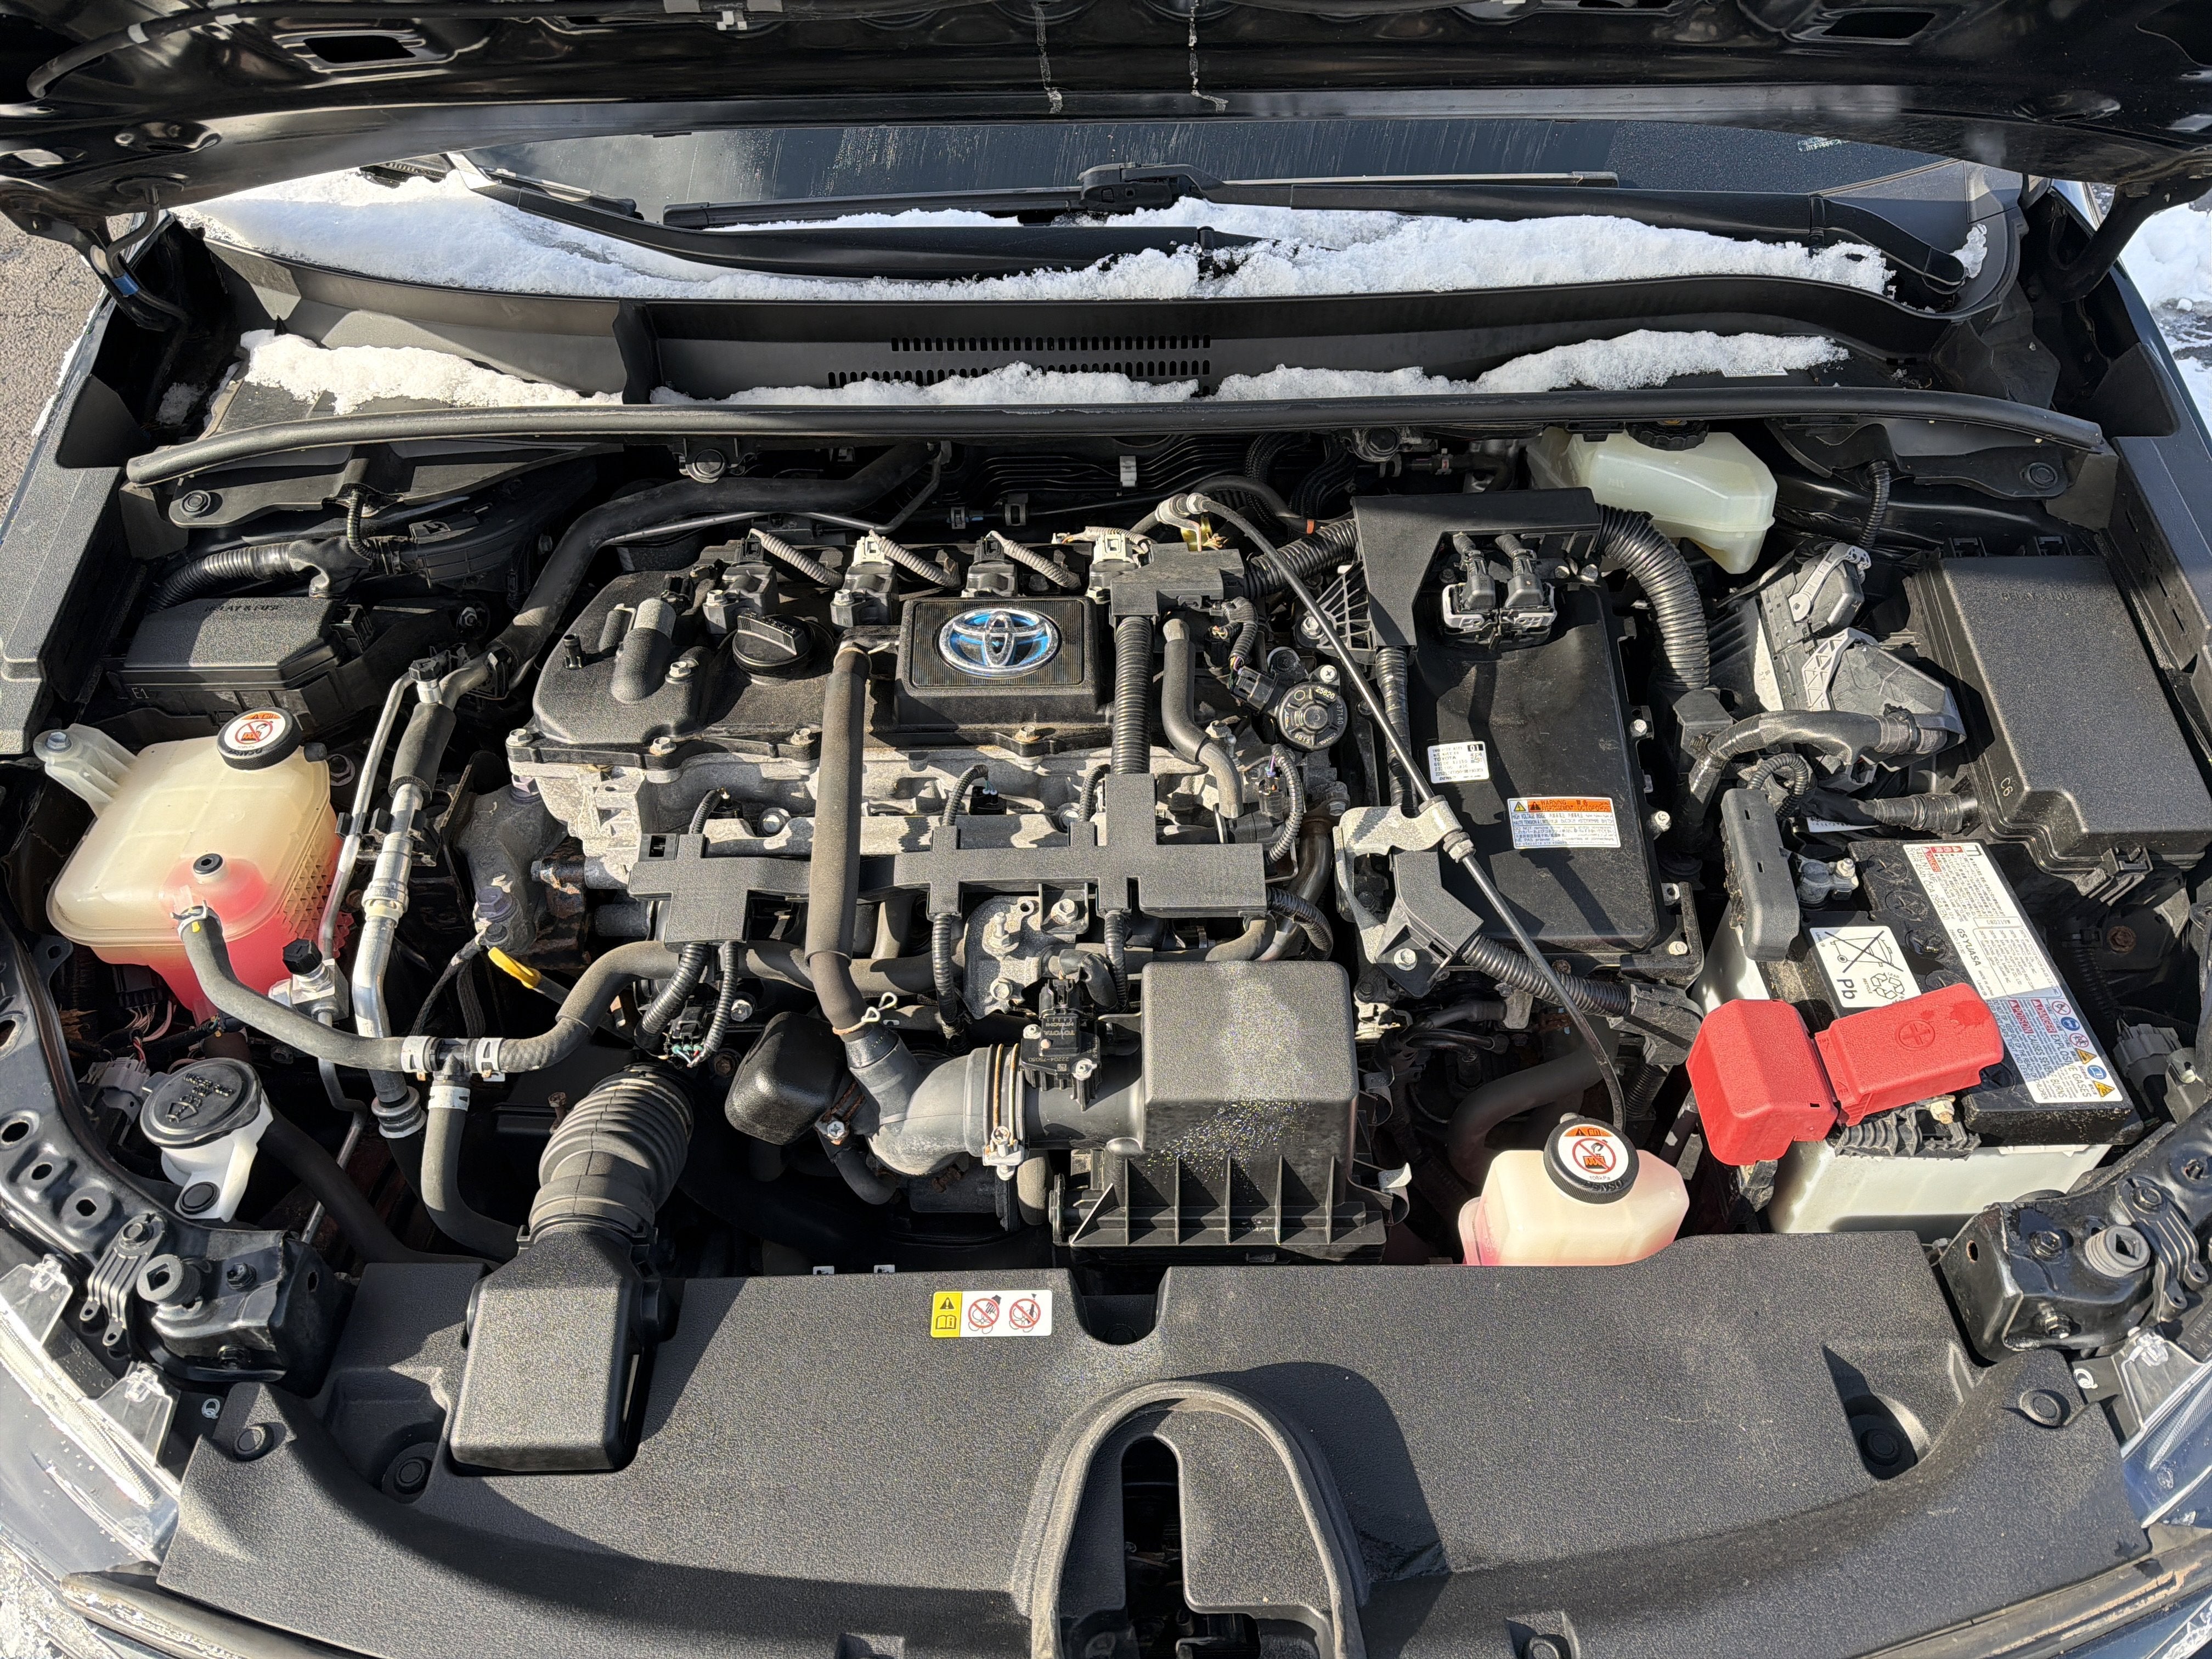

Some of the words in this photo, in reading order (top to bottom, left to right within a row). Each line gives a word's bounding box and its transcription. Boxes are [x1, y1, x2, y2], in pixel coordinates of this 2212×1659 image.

[205, 604, 243, 612] RELAY
[131, 687, 149, 699] E1
[2001, 777, 2013, 797] C6
[1923, 880, 1935, 893] CCA
[1956, 929, 1966, 938] GS
[1962, 938, 1982, 966] YUASA
[1836, 979, 1858, 1000] Pb
[1862, 978, 1873, 994] RECYCLE
[1987, 999, 1996, 1011] KEEP
[1994, 1012, 2002, 1024] VENT
[2000, 1024, 2010, 1037] CAPS
[2006, 1039, 2016, 1052] TIGHT
[2013, 1053, 2022, 1064] AND
[2019, 1064, 2031, 1080] LEVEL
[1996, 1006, 2004, 1014] NOT
[2006, 1023, 2014, 1033] KEEP
[2024, 1058, 2033, 1072] REACH
[2035, 1079, 2048, 1099] CHILDREN
[2012, 1007, 2033, 1032] POISON
[2027, 1035, 2045, 1055] CAUSES
[2039, 1057, 2057, 1077] SEVERE
[2050, 1079, 2068, 1098] BURNS
[2035, 1006, 2057, 1032] DANGER
[2050, 1034, 2078, 1071] EXPLOSIVE
[2071, 1073, 2092, 1097] GASES
